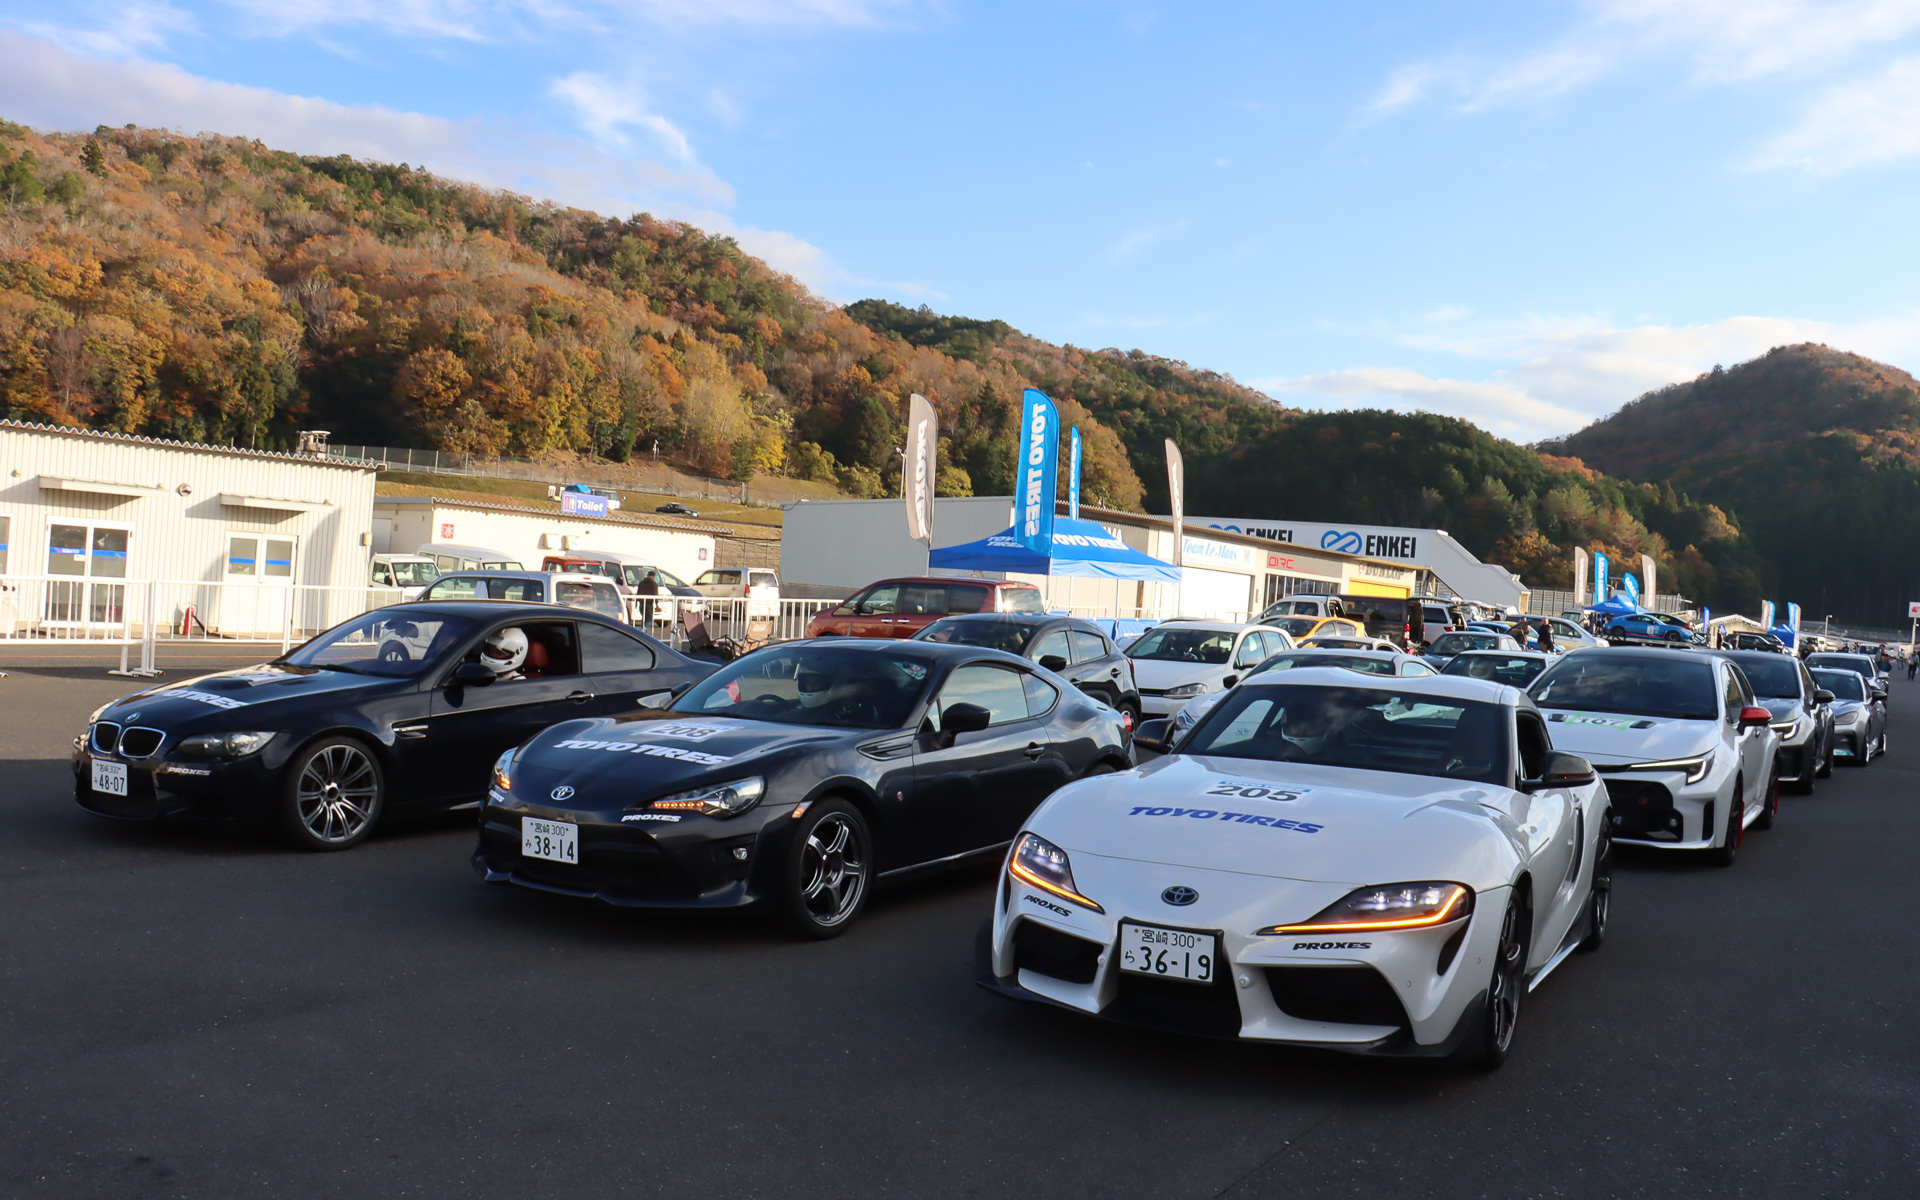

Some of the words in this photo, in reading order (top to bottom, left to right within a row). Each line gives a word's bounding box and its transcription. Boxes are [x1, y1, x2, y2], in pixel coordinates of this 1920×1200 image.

[577, 500, 603, 512] Toilet
[1182, 539, 1204, 555] Team
[1215, 544, 1238, 560] Mans
[1365, 535, 1416, 559] ENKEI
[1365, 563, 1405, 580] DUNLOP
[177, 691, 250, 709] TIRES
[648, 726, 717, 737] 208
[553, 740, 638, 752] TOYO
[631, 744, 733, 765] TIRES
[168, 767, 211, 776] PROXES
[99, 774, 125, 793] 48-07
[1206, 785, 1302, 801] 205
[621, 814, 682, 823] PROXES
[1128, 807, 1218, 819] TOYO
[1220, 812, 1325, 834] TIRES
[551, 825, 565, 836] 300
[534, 835, 575, 861] 38-14
[1023, 894, 1073, 917] PROXES
[1141, 929, 1168, 945] 宮崎
[1171, 932, 1195, 949] 300
[1292, 942, 1373, 951] PROXES
[1125, 949, 1135, 964] ら
[1139, 946, 1211, 981] 36-19
